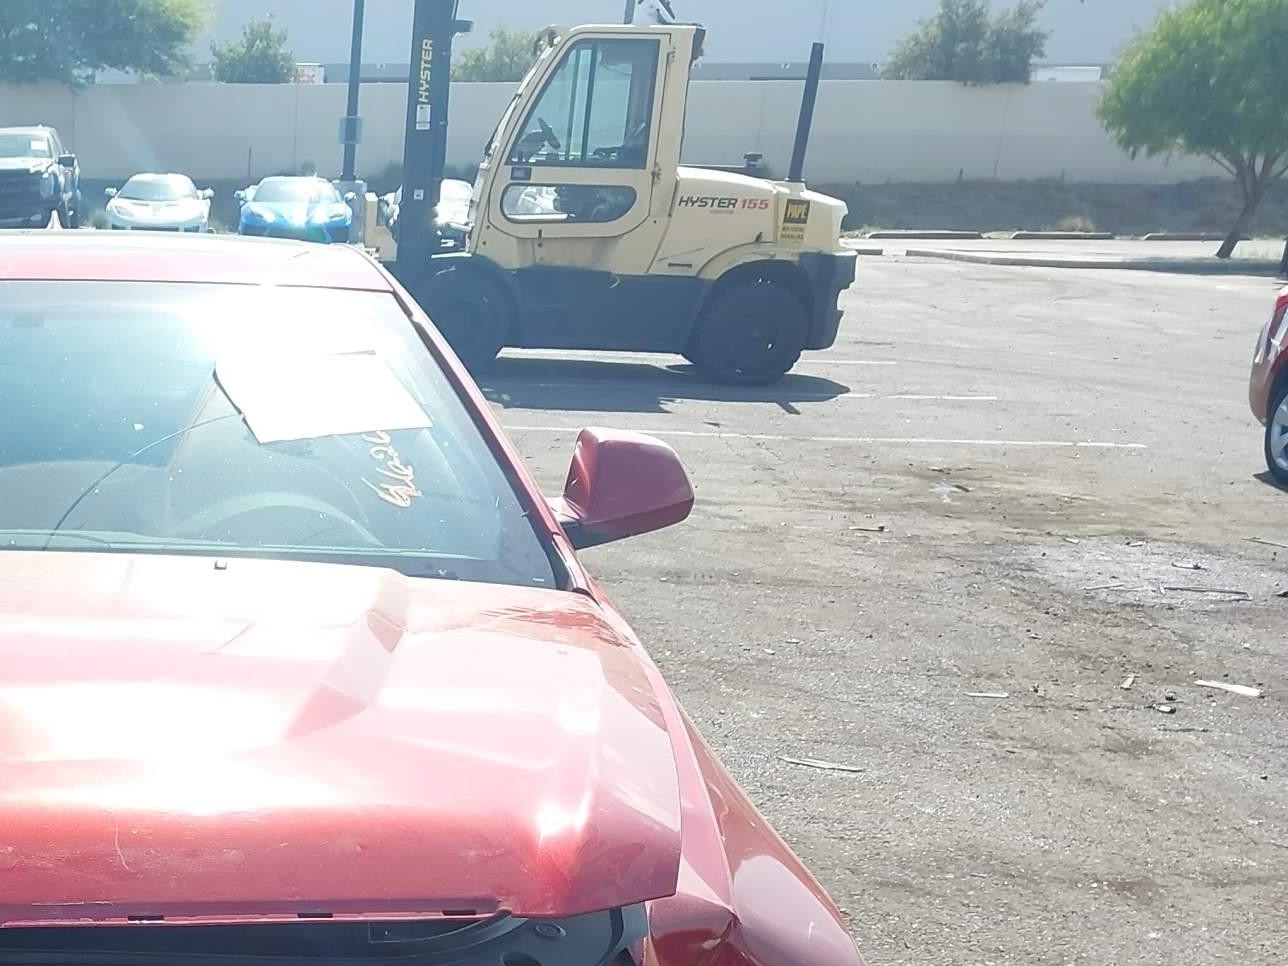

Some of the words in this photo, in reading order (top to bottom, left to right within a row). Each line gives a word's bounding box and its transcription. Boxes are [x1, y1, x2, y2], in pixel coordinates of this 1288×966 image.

[418, 38, 433, 103] HYSTER
[678, 195, 738, 208] HYSTER
[742, 198, 770, 209] 155
